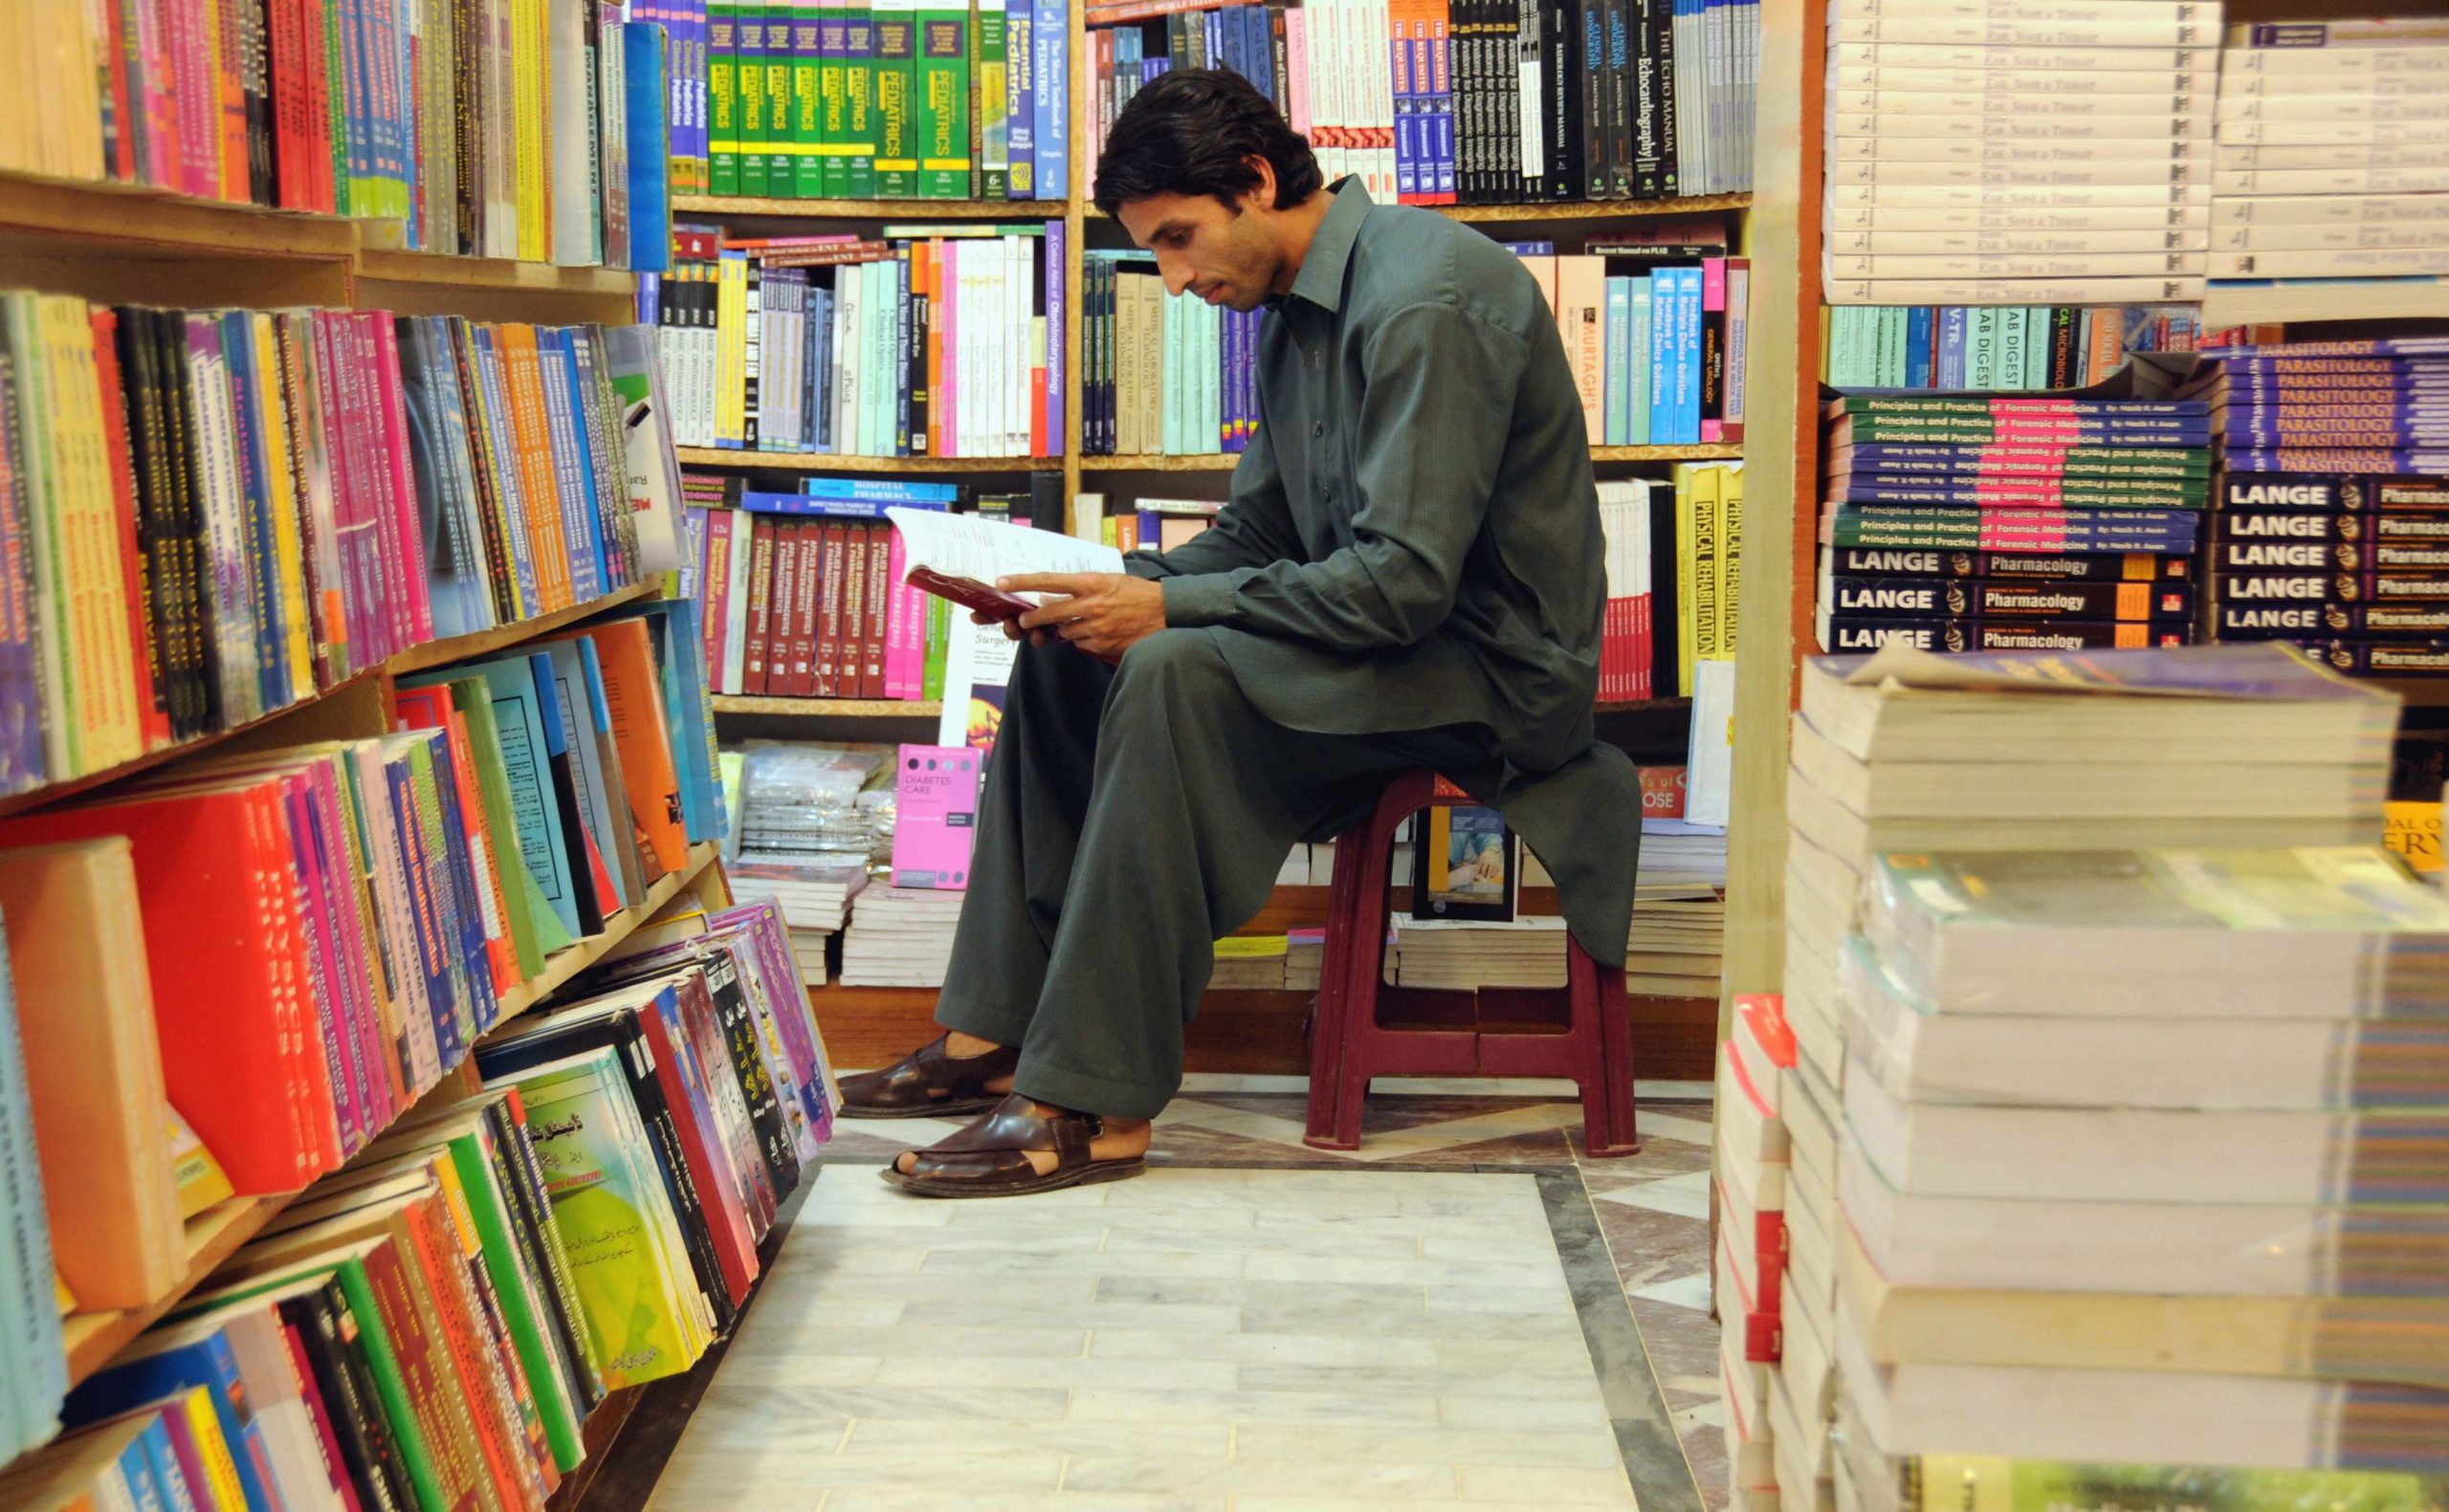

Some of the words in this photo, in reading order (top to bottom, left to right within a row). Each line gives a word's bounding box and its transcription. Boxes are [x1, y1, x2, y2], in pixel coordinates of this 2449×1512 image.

[1052, 39, 1061, 55] The
[1275, 40, 1285, 58] Atlas
[1435, 21, 1444, 38] THE
[1617, 23, 1625, 65] CLINICAL
[1660, 29, 1671, 55] THE
[1007, 20, 1020, 117] Pediatrics
[1021, 20, 1031, 90] Essential
[1037, 39, 1048, 107] PEDIATRICS
[1052, 57, 1061, 82] Short
[1276, 60, 1286, 72] of
[1417, 39, 1427, 93] REQUISITES
[1436, 39, 1446, 92] REQUISITES
[1496, 38, 1506, 77] Anatomy
[1555, 43, 1564, 86] RADIOLOGY
[716, 64, 730, 128] PEDIATRICS
[1277, 73, 1288, 118] Ultrasound
[1661, 59, 1673, 96] ECHO
[800, 67, 814, 131] PEDIATRICS
[886, 71, 900, 157] PEDIATRICS
[935, 70, 951, 157] PEDIATRICS
[1052, 85, 1061, 126] Textbook
[1498, 92, 1507, 136] Diagnostic
[1637, 57, 1656, 157] Echocardiography
[1052, 128, 1062, 139] of
[1420, 120, 1429, 158] Ultrasound
[1439, 119, 1447, 157] Ultrasound
[1556, 117, 1565, 149] MANUAL
[1663, 99, 1673, 154] MANUAL
[1499, 137, 1509, 171] Imaging
[1050, 243, 1059, 268] Colour
[1050, 270, 1059, 291] Atlas
[1149, 306, 1158, 348] MEDICAL
[1677, 296, 1688, 332] Multiple
[1688, 296, 1699, 338] Handbook
[691, 331, 699, 351] BASIC
[706, 332, 715, 353] BASIC
[1049, 301, 1060, 395] Otorhinolaryngology
[1678, 334, 1688, 361] Choice
[1688, 340, 1697, 349] of
[1706, 328, 1714, 364] GENERAL
[1730, 318, 1738, 362] QUESTIONS
[1736, 319, 1745, 358] PREVIOUS
[1141, 328, 1150, 389] TECHNOLOGY
[1582, 323, 1596, 411] MURTAGH'S
[1976, 339, 1990, 388] DIGEST
[2005, 336, 2019, 385] DIGEST
[2274, 359, 2393, 373] PARASITOLOGY
[690, 354, 699, 421] OPHTHALMOLOGY
[704, 356, 715, 422] OPHTHALMOLOGY
[1149, 355, 1158, 410] LABORATORY
[1676, 363, 1687, 405] Questions
[2277, 374, 2393, 388] PARASITOLOGY
[1868, 401, 1919, 413] Principles
[1922, 402, 1942, 412] and
[1945, 403, 1987, 413] Practice
[1989, 403, 2001, 413] of
[2004, 404, 2048, 414] Forensic
[2050, 404, 2099, 415] Medicine
[2280, 432, 2396, 447] PARASITOLOGY
[366, 368, 386, 443] DIGITAL
[378, 448, 409, 602] FUNDAMENTALS
[854, 481, 905, 491] HOSPITAL
[2230, 485, 2329, 505] LANGE
[1696, 502, 1713, 557] PHYSICAL
[1859, 535, 1909, 547] Principles
[1912, 537, 1932, 546] and
[1934, 537, 1977, 547] Practice
[1979, 537, 1992, 548] of
[1996, 538, 2039, 549] Forensic
[2041, 538, 2088, 551] Medicine
[2230, 515, 2328, 537] LANGE
[246, 498, 267, 629] Marketing
[716, 537, 727, 582] Dispensing
[879, 542, 888, 569] APPLIED
[1848, 551, 1939, 572] LANGE
[1990, 556, 2088, 576] Pharmacology
[2228, 545, 2327, 565] LANGE
[869, 549, 879, 615] PHARMACOKINETICS
[1841, 589, 1934, 609] LANGE
[2228, 577, 2327, 599] LANGE
[875, 572, 887, 637] BIOPHARMACEUTICS
[1697, 558, 1715, 653] REHABILITATION
[1985, 592, 2086, 612] Pharmacology
[2226, 609, 2317, 627] LANGE
[1983, 631, 2084, 650] Pharmacology
[904, 775, 951, 786] DIABETES
[904, 785, 932, 796] CARE
[388, 828, 408, 902] SIGNALS
[403, 906, 409, 917] &
[406, 923, 427, 1000] SYSTEMS
[254, 870, 290, 1056] PHYSICS
[270, 870, 304, 1056] PHYSICS
[566, 1171, 601, 1186] GUIDE
[476, 1254, 493, 1288] Time
[487, 1288, 507, 1331] Signal
[502, 1332, 534, 1410] Processing
